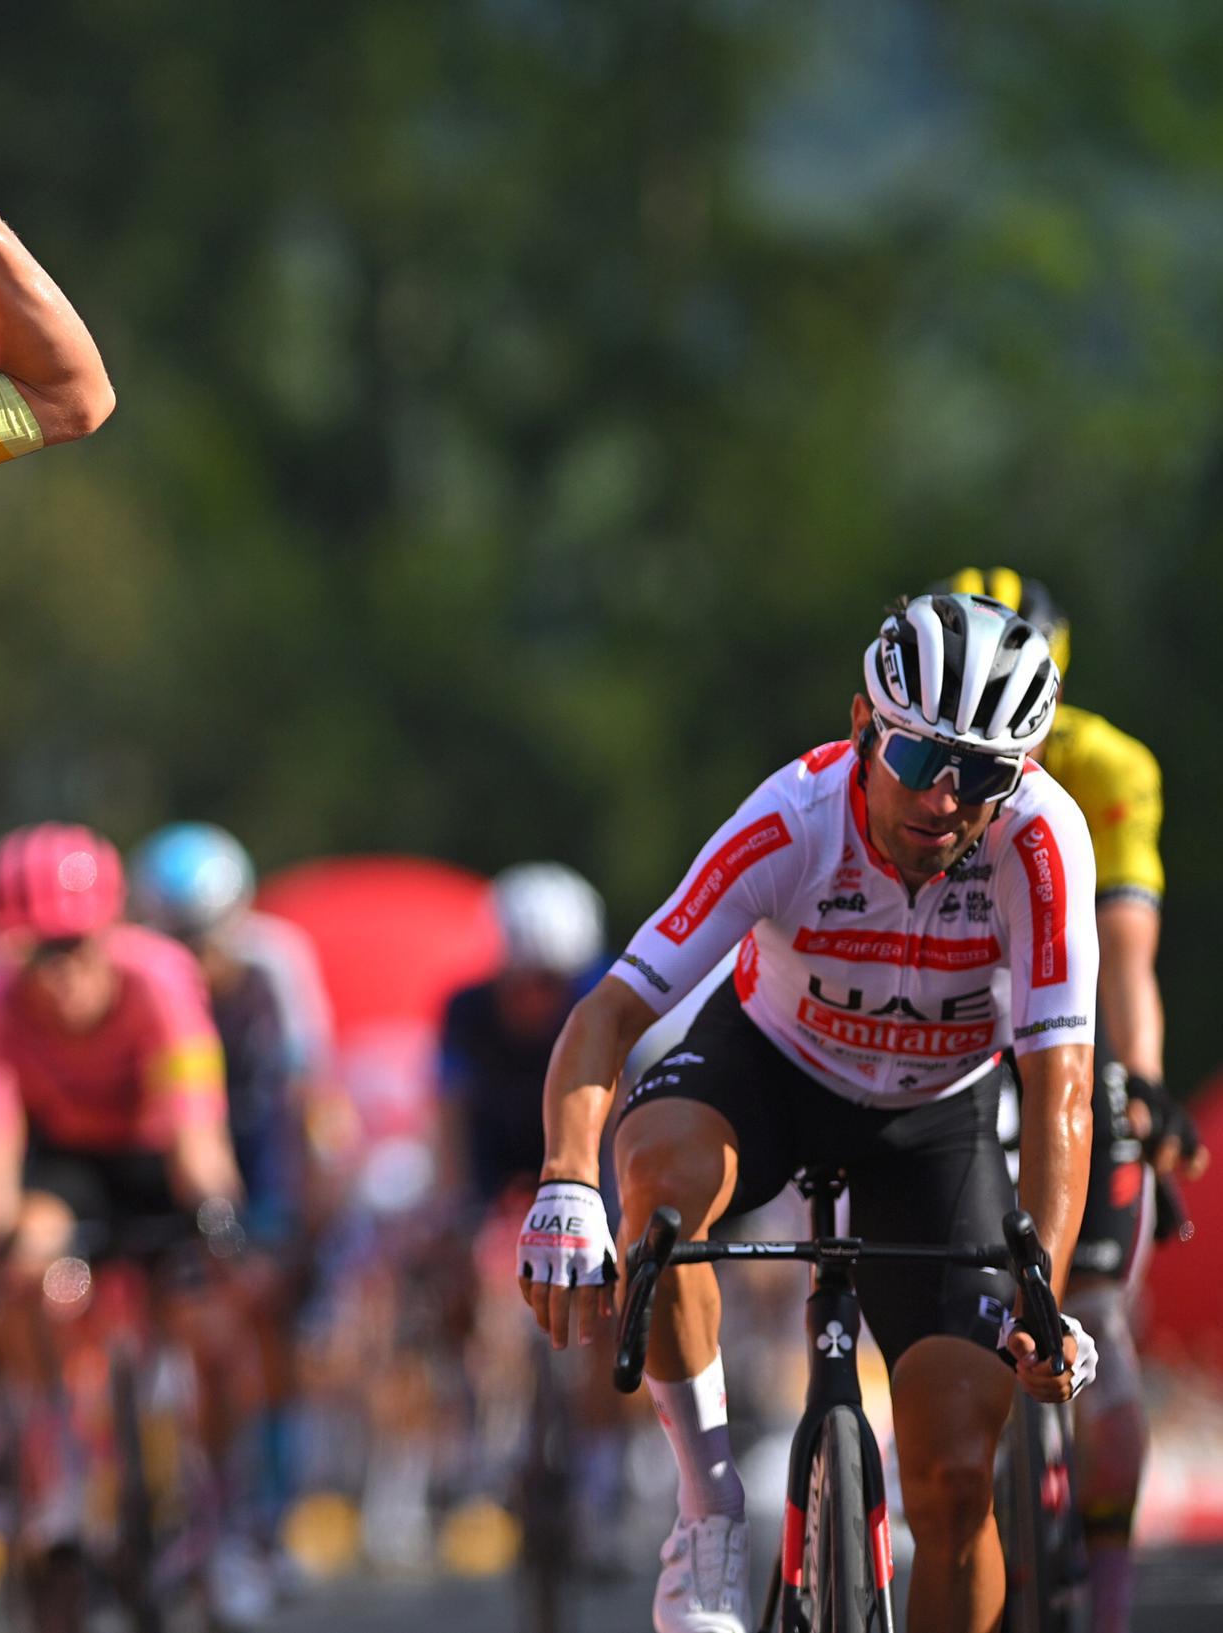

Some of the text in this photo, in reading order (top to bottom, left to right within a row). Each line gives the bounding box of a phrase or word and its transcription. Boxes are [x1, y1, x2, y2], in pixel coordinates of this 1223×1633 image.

[835, 938, 903, 958] Energa
[809, 974, 992, 1022] UAE
[804, 1004, 989, 1056] Emirates
[529, 1214, 586, 1234] UAE
